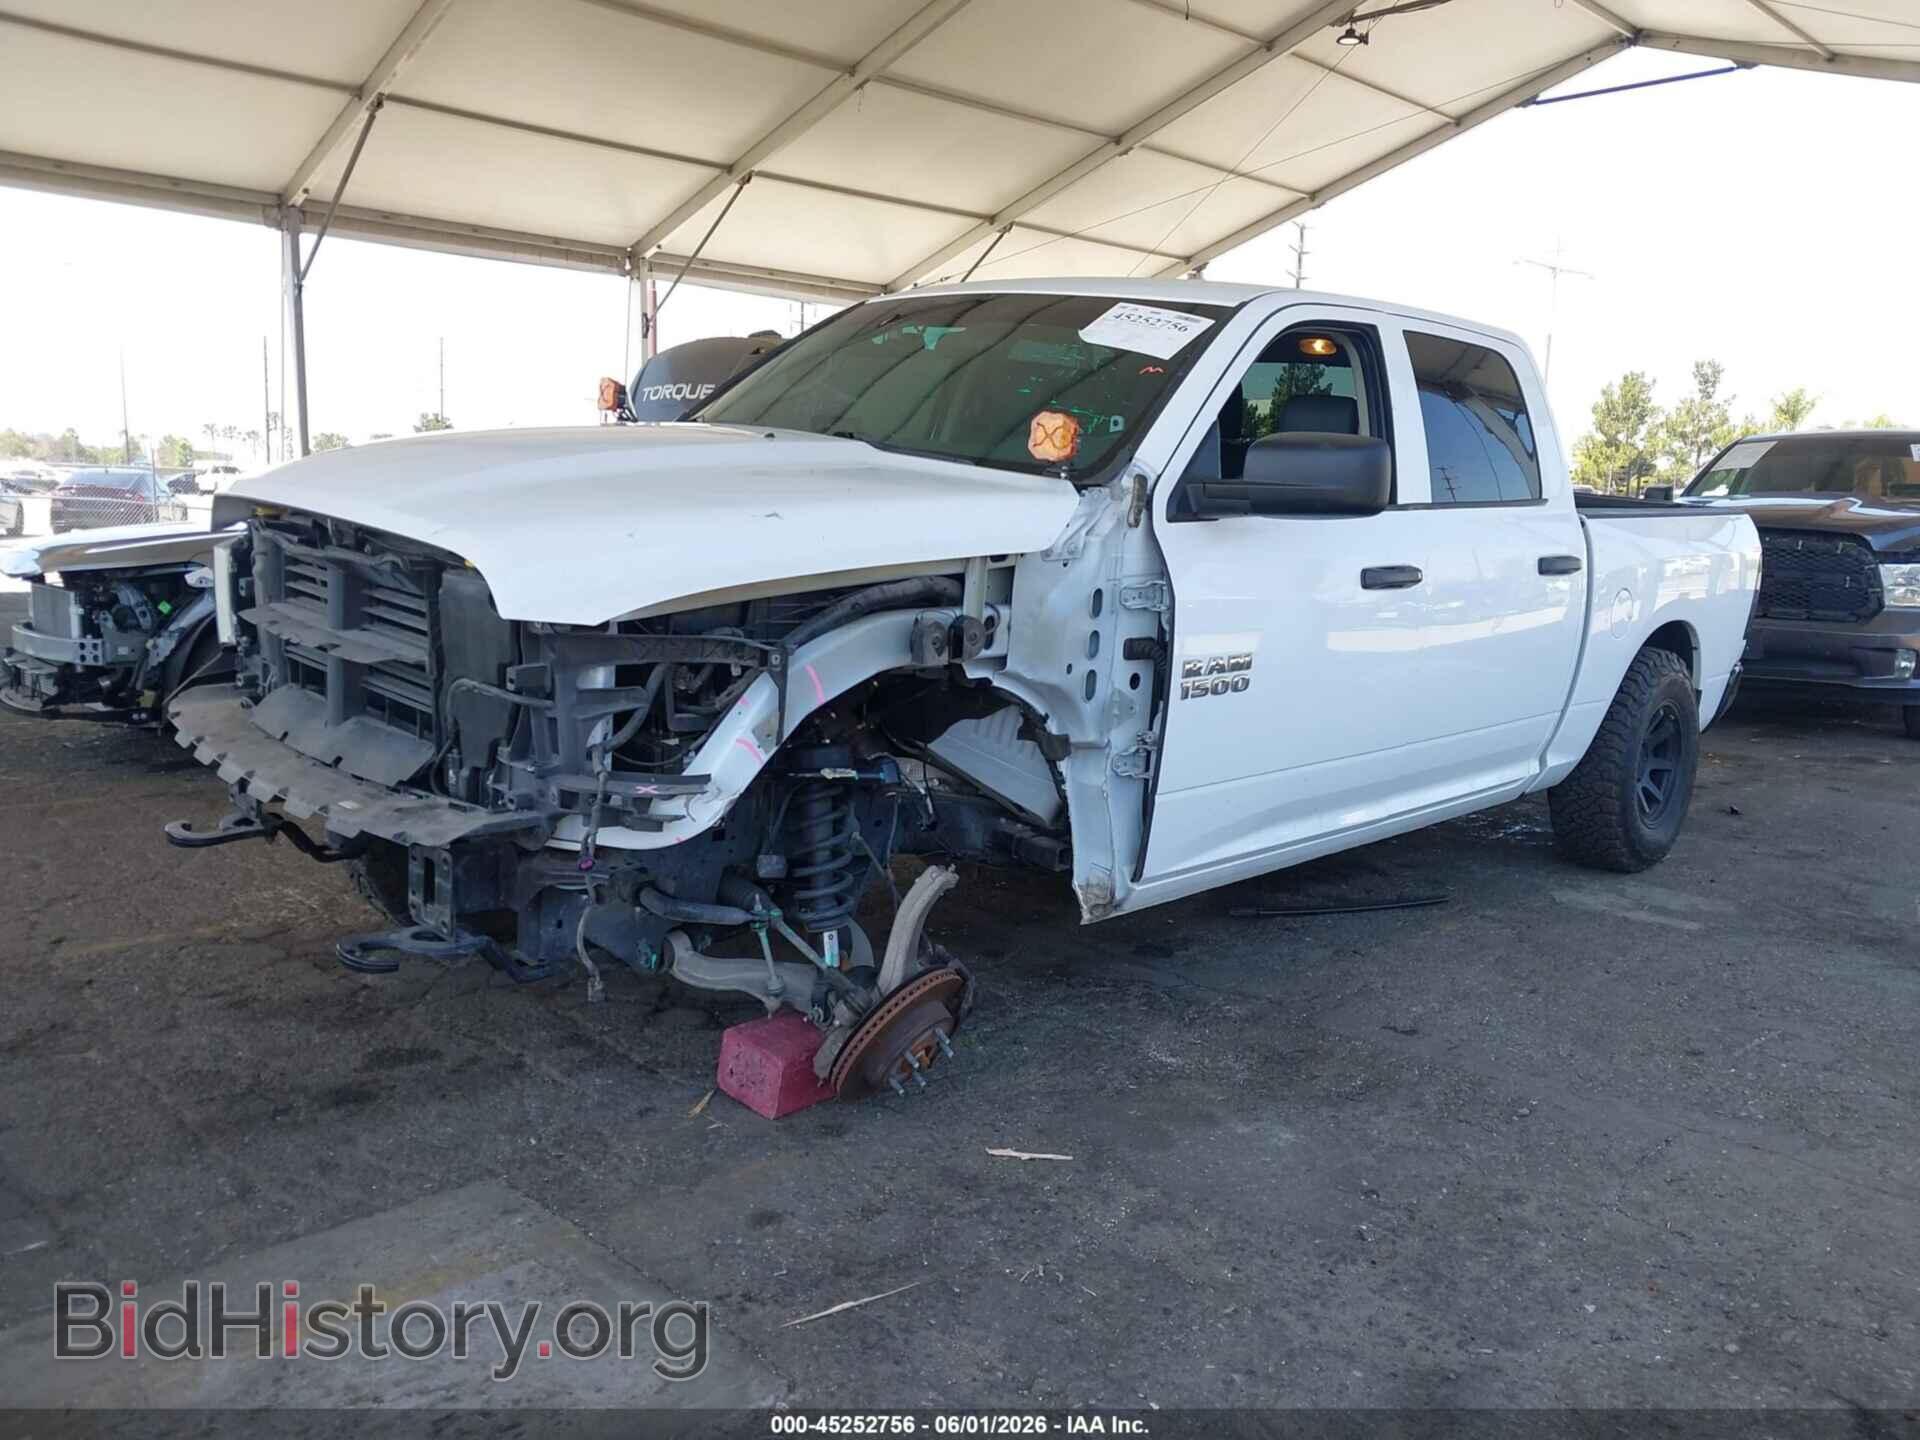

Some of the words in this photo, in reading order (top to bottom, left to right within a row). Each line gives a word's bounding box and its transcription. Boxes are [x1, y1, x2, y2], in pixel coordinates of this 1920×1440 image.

[642, 383, 716, 402] TORQUE
[1182, 653, 1253, 679] RAM
[1180, 674, 1250, 701] 1500
